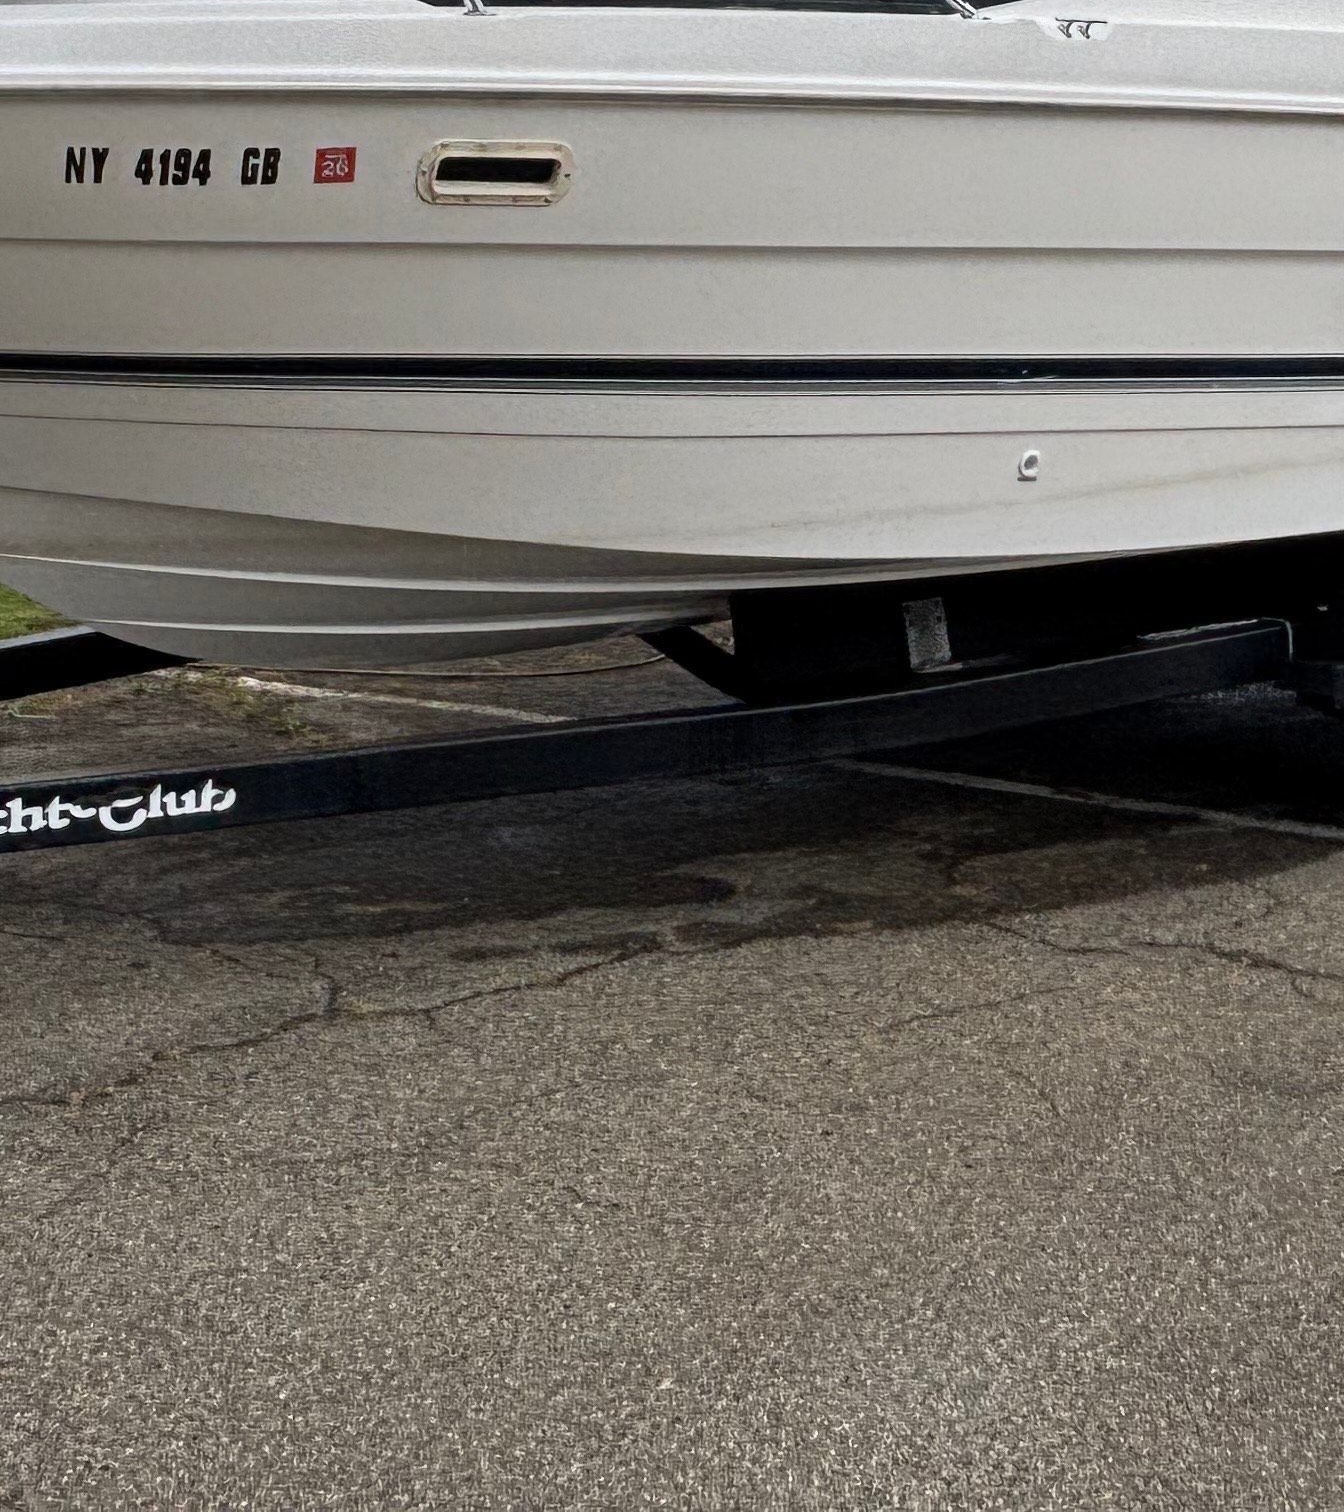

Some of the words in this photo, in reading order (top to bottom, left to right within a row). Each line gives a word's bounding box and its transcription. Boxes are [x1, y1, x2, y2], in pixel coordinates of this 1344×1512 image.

[65, 147, 109, 183] NY
[134, 148, 212, 186] 4194
[240, 147, 282, 186] GB
[98, 778, 237, 832] Club
